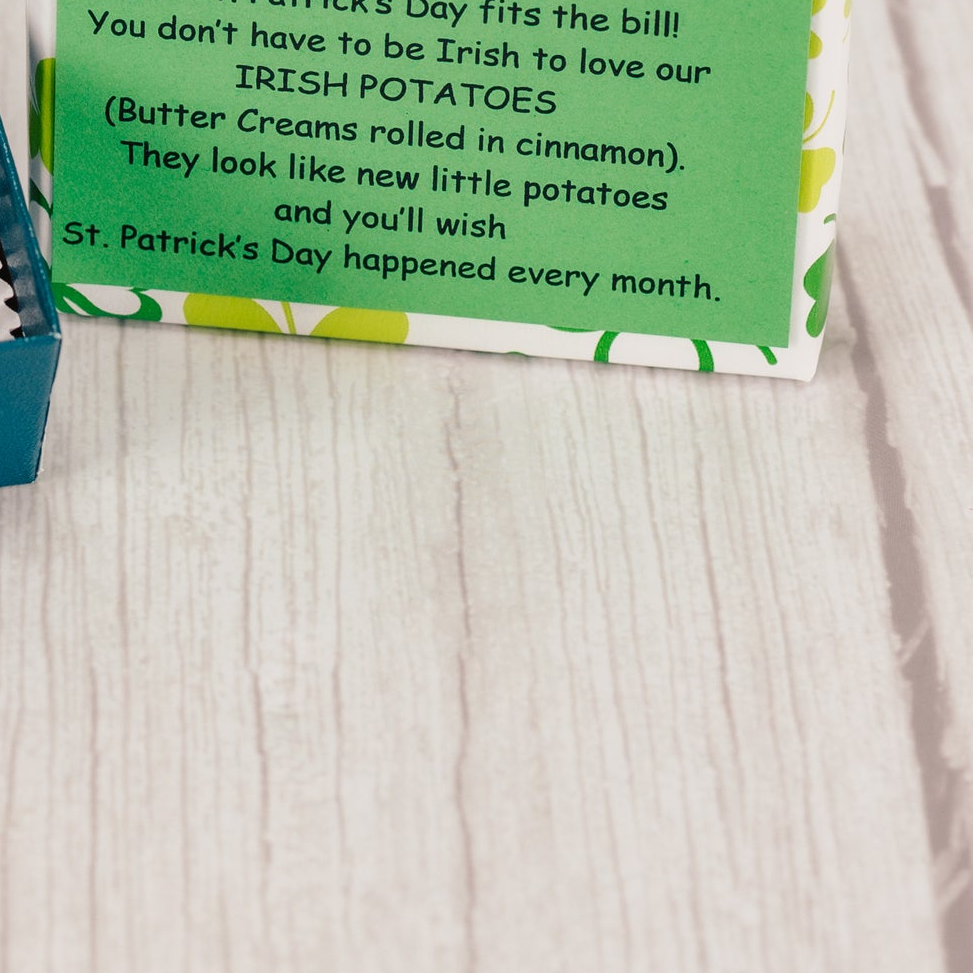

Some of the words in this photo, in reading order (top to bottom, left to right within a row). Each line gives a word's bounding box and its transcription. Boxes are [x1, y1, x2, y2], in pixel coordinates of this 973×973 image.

[87, 9, 146, 39] You
[157, 14, 238, 45] don't
[251, 21, 326, 53] have
[337, 31, 372, 56] to
[384, 32, 425, 61] be
[436, 37, 520, 69] Irish
[532, 47, 567, 73] to
[580, 47, 645, 79] love
[655, 63, 712, 84] our
[552, 3, 610, 32] the
[621, 7, 679, 39] bill!
[235, 64, 348, 98] IRISH
[360, 73, 557, 115] POTATOES
[104, 95, 226, 130] (Butter
[237, 108, 358, 142] Creams
[370, 119, 465, 150] rolled
[478, 127, 504, 154] in
[516, 132, 685, 174] cinnamon).
[119, 139, 200, 179] They
[212, 145, 277, 179] look
[289, 152, 346, 184] like
[357, 167, 420, 191] new
[432, 164, 512, 198] little
[523, 179, 669, 211] potatoes
[273, 199, 332, 225] and
[342, 206, 424, 235] you'll
[436, 212, 506, 240] wish
[62, 220, 109, 249] St.
[120, 223, 259, 261] Patrick's
[271, 234, 333, 275] Day
[343, 243, 496, 282] happened
[508, 265, 600, 297] every
[611, 273, 721, 302] month.
